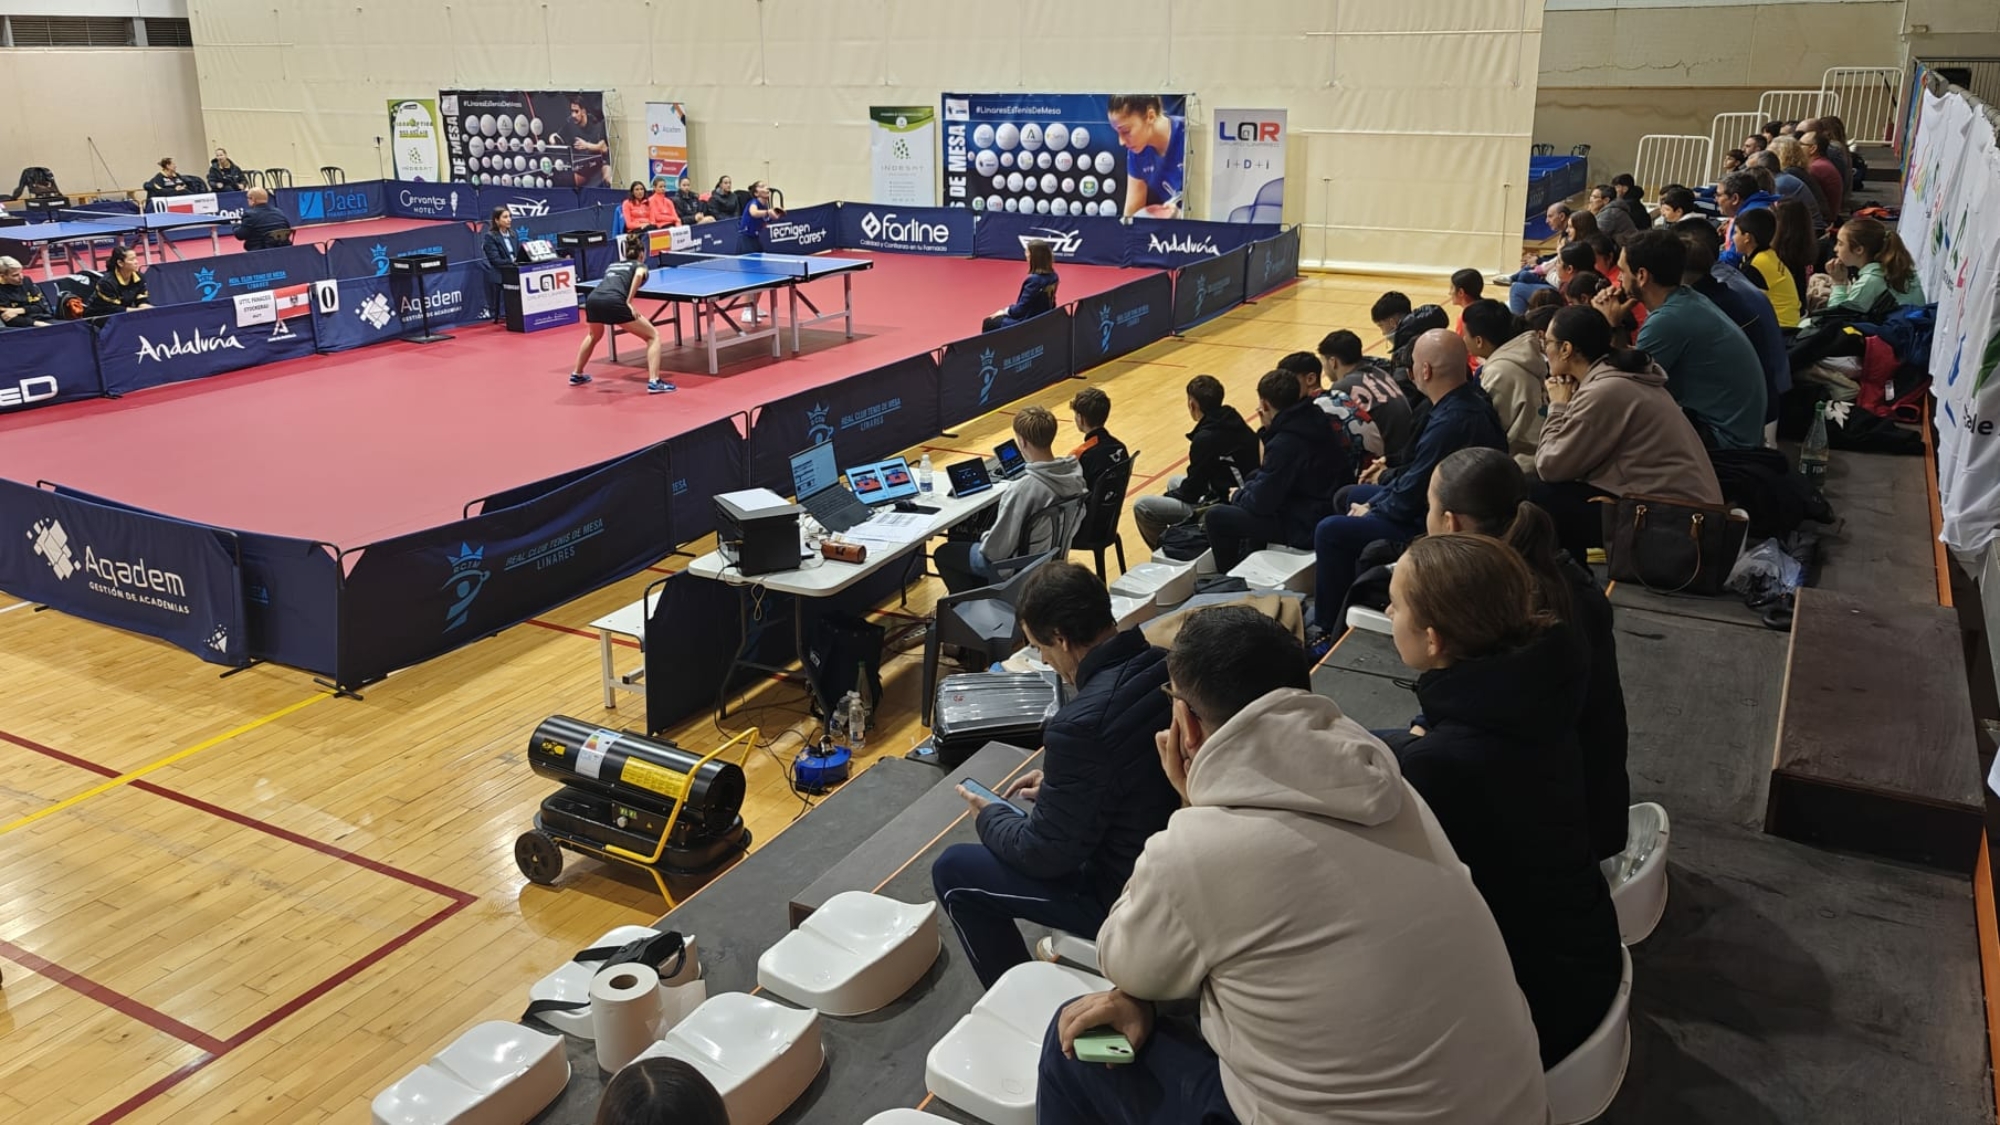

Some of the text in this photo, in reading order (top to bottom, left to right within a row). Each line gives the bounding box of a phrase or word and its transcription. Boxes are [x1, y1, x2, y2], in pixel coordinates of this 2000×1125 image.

[447, 116, 464, 155] MESA
[948, 125, 967, 172] MESA
[452, 158, 467, 175] DE
[949, 176, 967, 197] DE
[400, 189, 446, 210] Cervantes
[413, 207, 435, 215] HOTEL
[1147, 233, 1220, 256] Andalucía
[321, 286, 336, 309] 0
[136, 325, 245, 364] Andalucía
[571, 529, 581, 540] DE
[582, 518, 604, 537] MESA
[537, 547, 576, 570] LINARES
[85, 545, 187, 598] Aqadem
[88, 581, 190, 614] GESTIÓN DE ACADEMIAS
